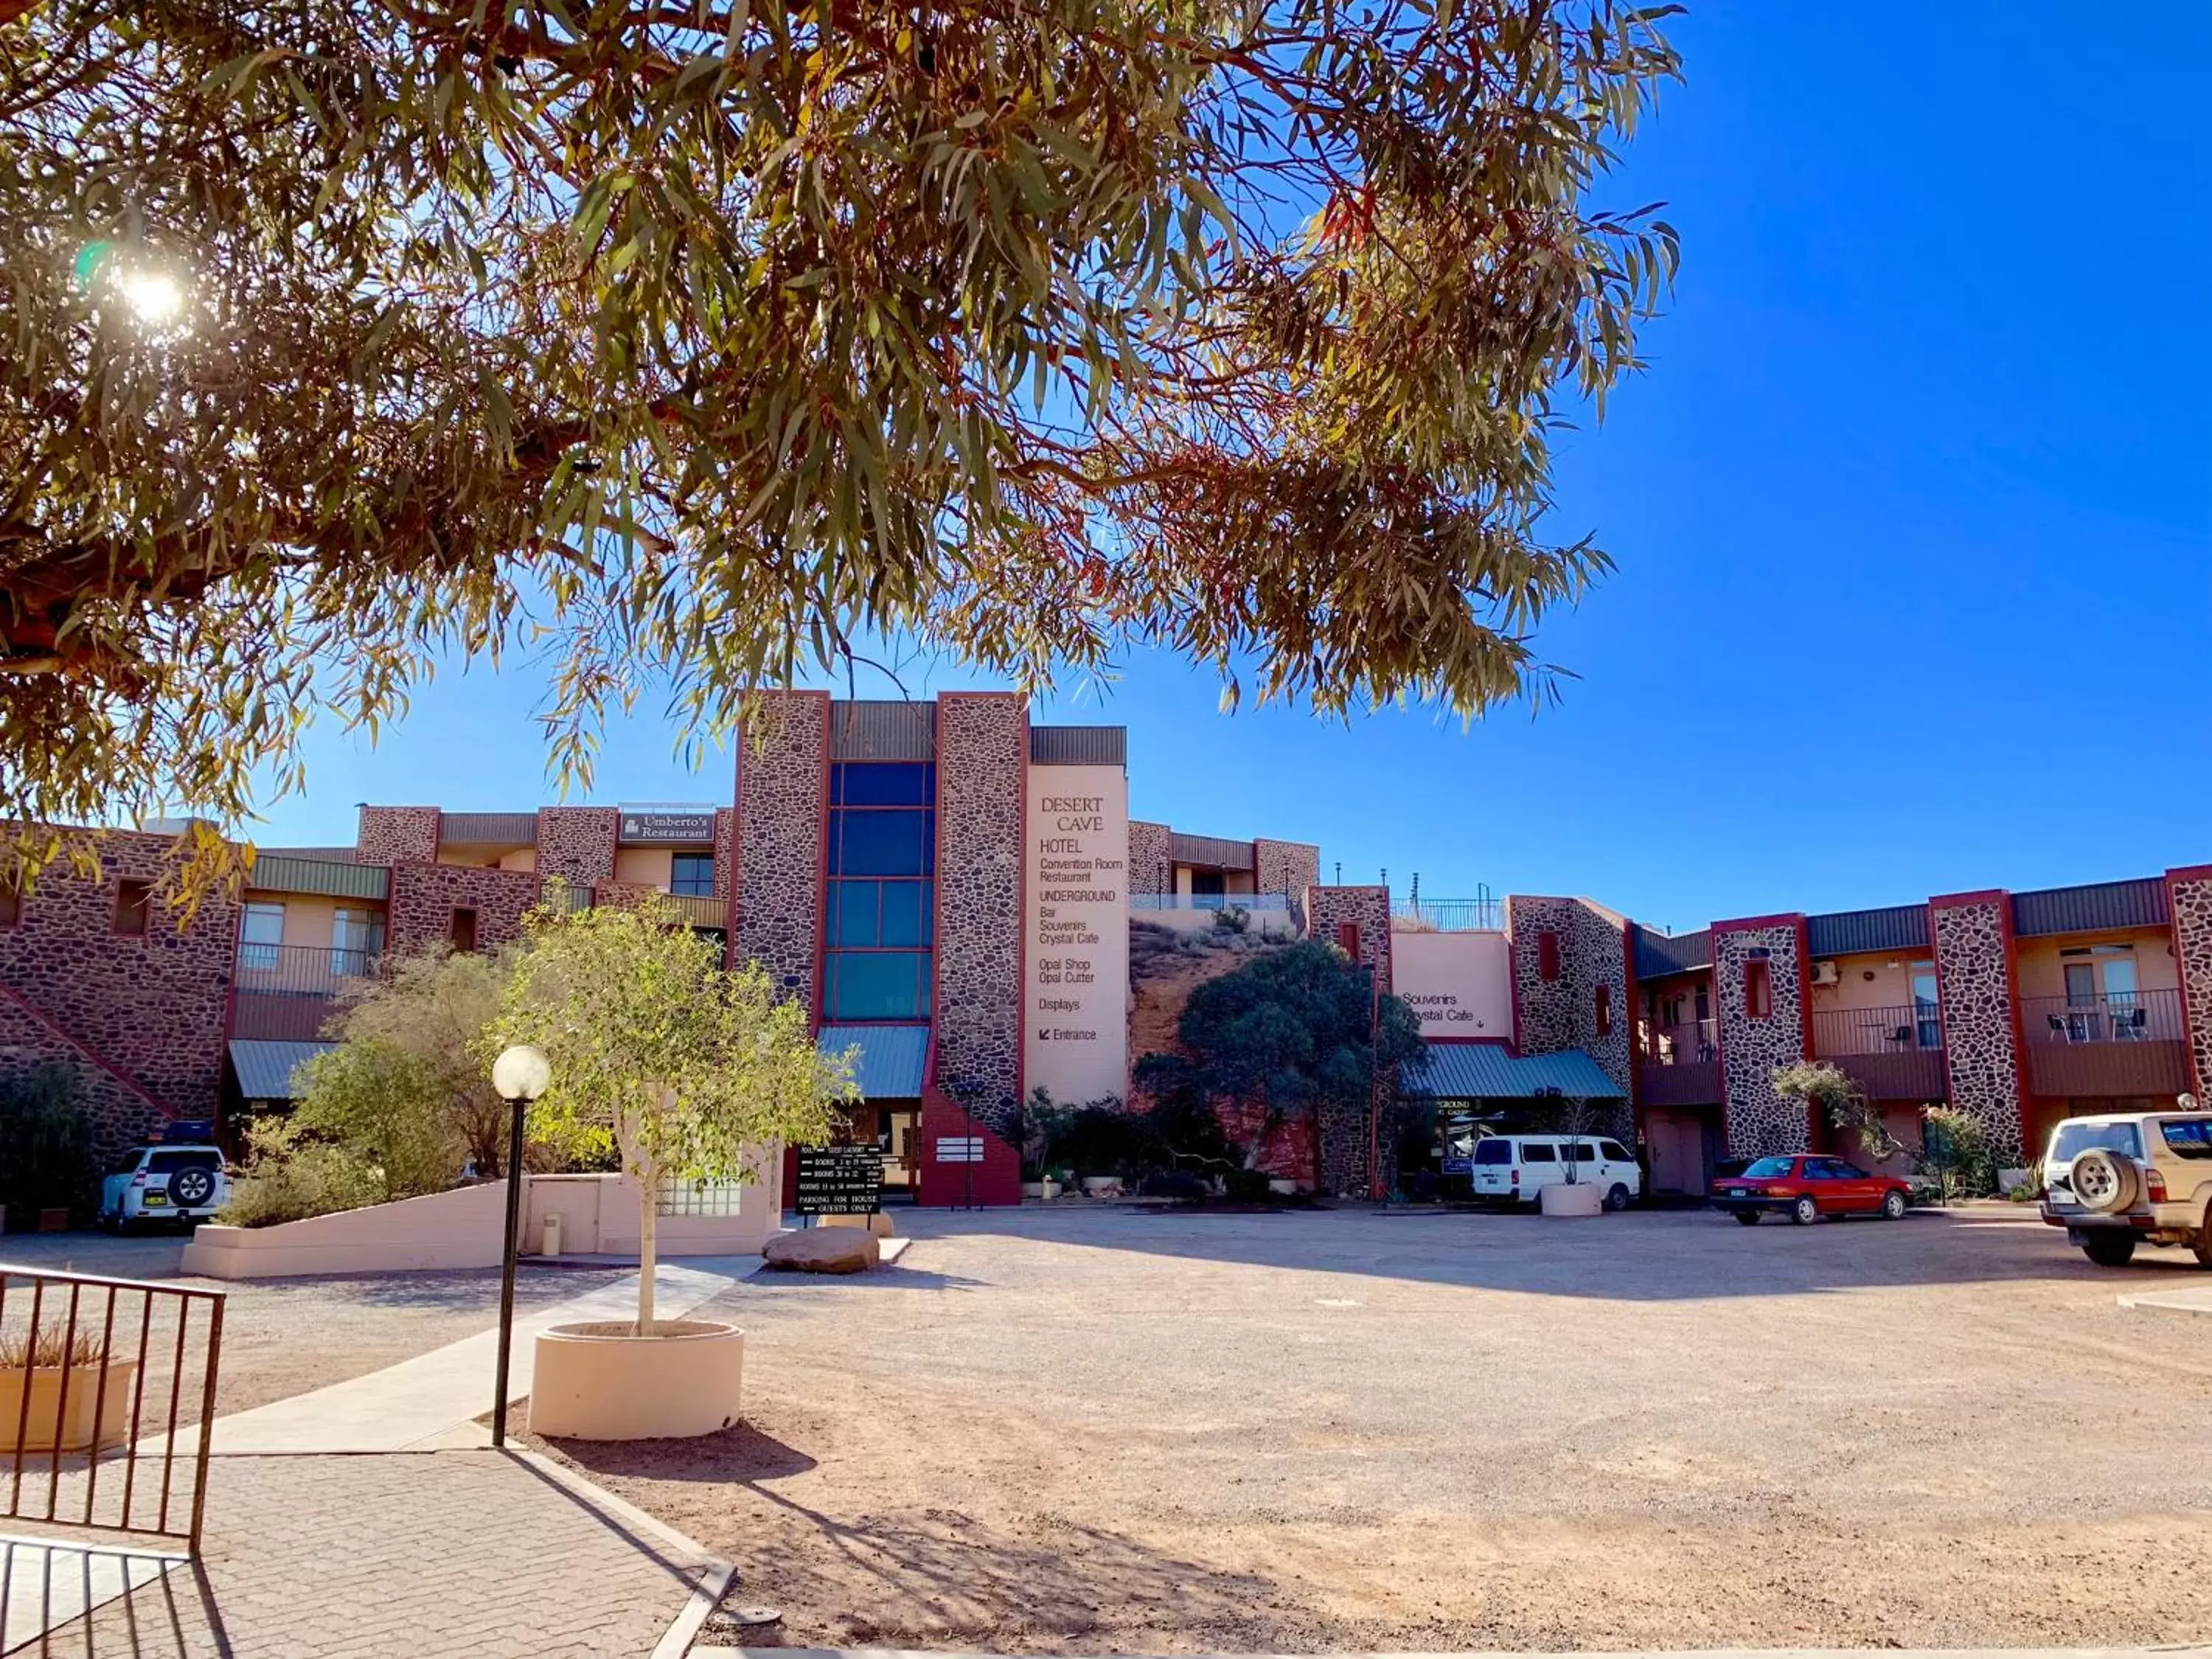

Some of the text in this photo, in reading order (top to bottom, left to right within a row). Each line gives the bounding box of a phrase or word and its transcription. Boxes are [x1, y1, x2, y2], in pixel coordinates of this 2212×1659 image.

[1041, 797, 1104, 812] DESERT
[644, 815, 708, 827] Umberto's
[1057, 816, 1104, 831] CAVE
[641, 827, 708, 838] Restaurant
[1040, 838, 1083, 853] HOTEL
[1040, 858, 1123, 869] Convention Room
[1040, 871, 1091, 883] Restaurant
[1040, 890, 1116, 901] UNDERGROUND
[1040, 906, 1055, 918] Bar
[1040, 919, 1086, 931] Souvenirs
[1039, 933, 1099, 946] Crystal Cafe
[1039, 959, 1091, 972] Opal Shop
[1039, 972, 1094, 985] Opal Cutter
[1402, 992, 1457, 1005] Souvenirs
[1039, 998, 1080, 1012] Displays
[1447, 1009, 1474, 1021] Cafe
[1053, 1029, 1096, 1040] Entrance
[799, 1196, 830, 1204] PARKING
[852, 1195, 877, 1203] HOUSE
[818, 1204, 873, 1212] GUESTS ONLY
